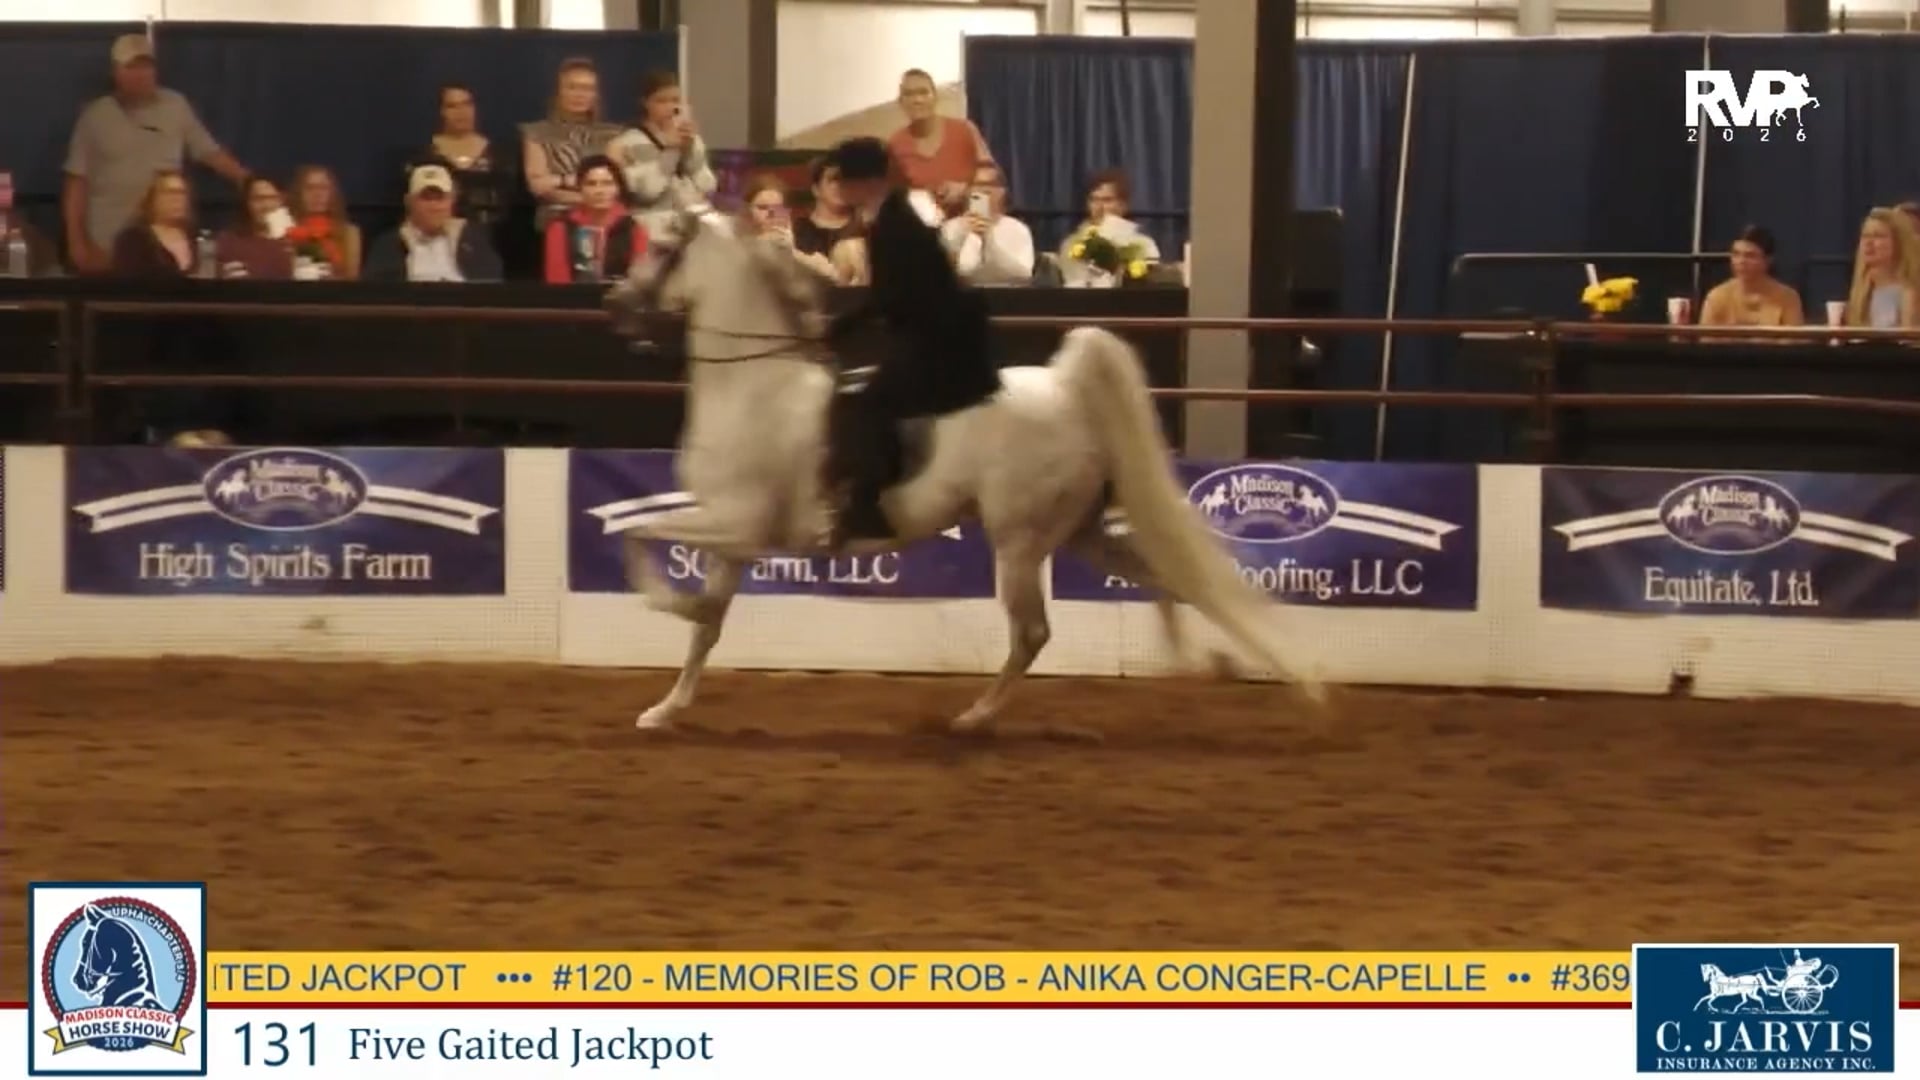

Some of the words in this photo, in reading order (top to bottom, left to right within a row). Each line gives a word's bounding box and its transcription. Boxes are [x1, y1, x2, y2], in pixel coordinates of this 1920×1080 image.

[139, 542, 216, 586] High
[226, 542, 332, 586] Spirits
[341, 543, 432, 580] Farm
[751, 555, 819, 583] arm,
[1232, 557, 1344, 601] oofing,
[1351, 559, 1423, 595] LLC
[1768, 570, 1820, 607] Ltd.
